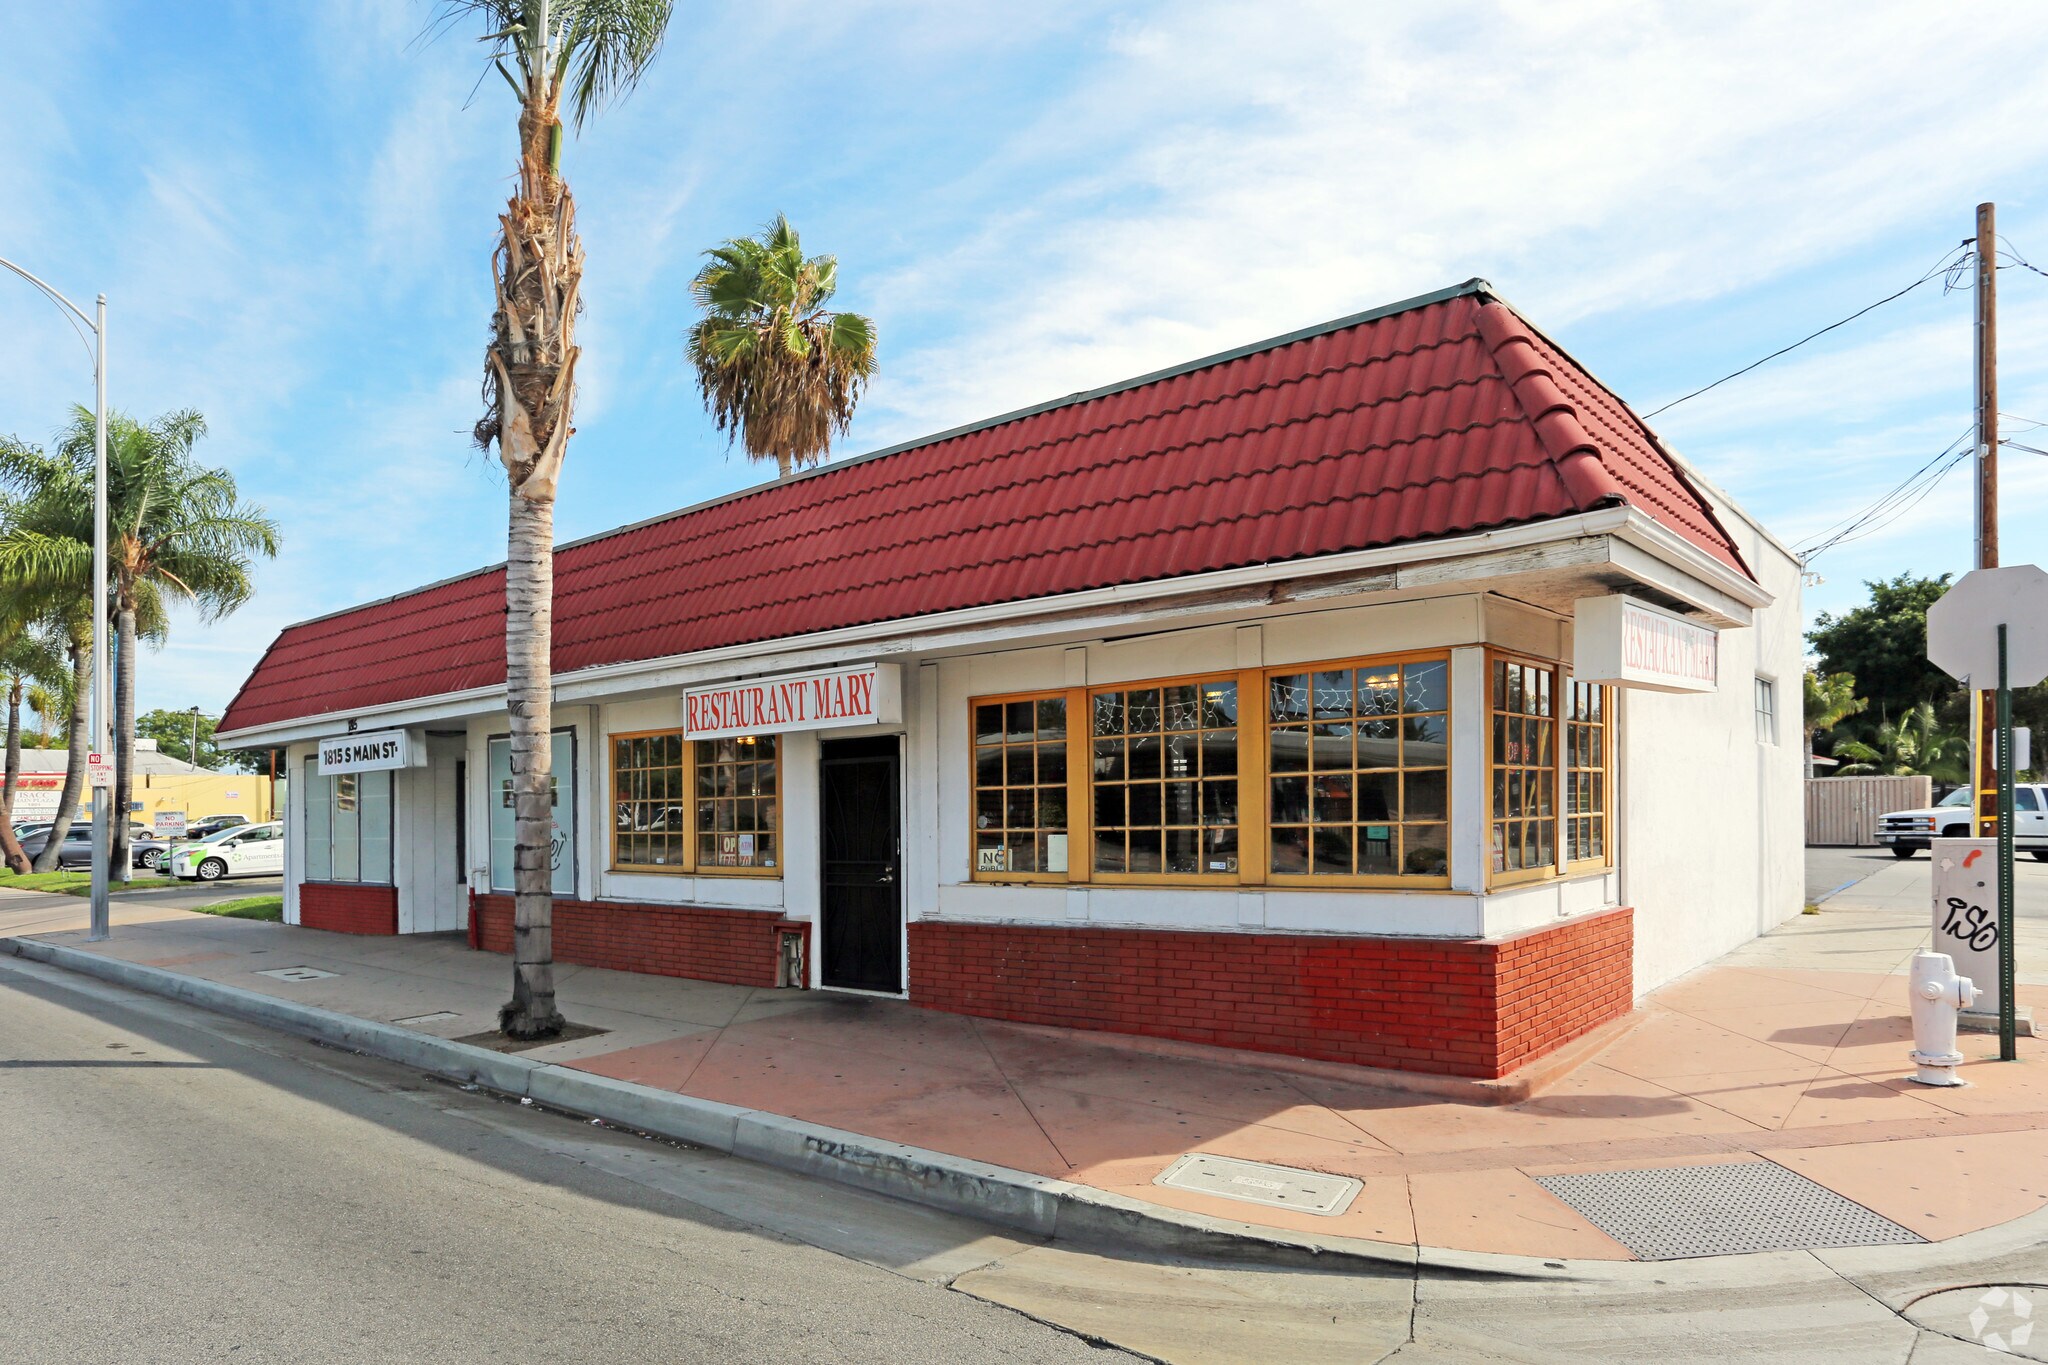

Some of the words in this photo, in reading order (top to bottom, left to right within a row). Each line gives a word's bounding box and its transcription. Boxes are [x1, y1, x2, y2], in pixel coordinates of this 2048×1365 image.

[687, 681, 808, 732] RESTAURANT
[812, 672, 875, 720] MARY
[90, 755, 100, 763] NO
[323, 748, 343, 766] 1815
[344, 747, 351, 763] S
[353, 743, 381, 762] MAIN
[1507, 741, 1531, 763] OPN
[723, 837, 736, 853] OP
